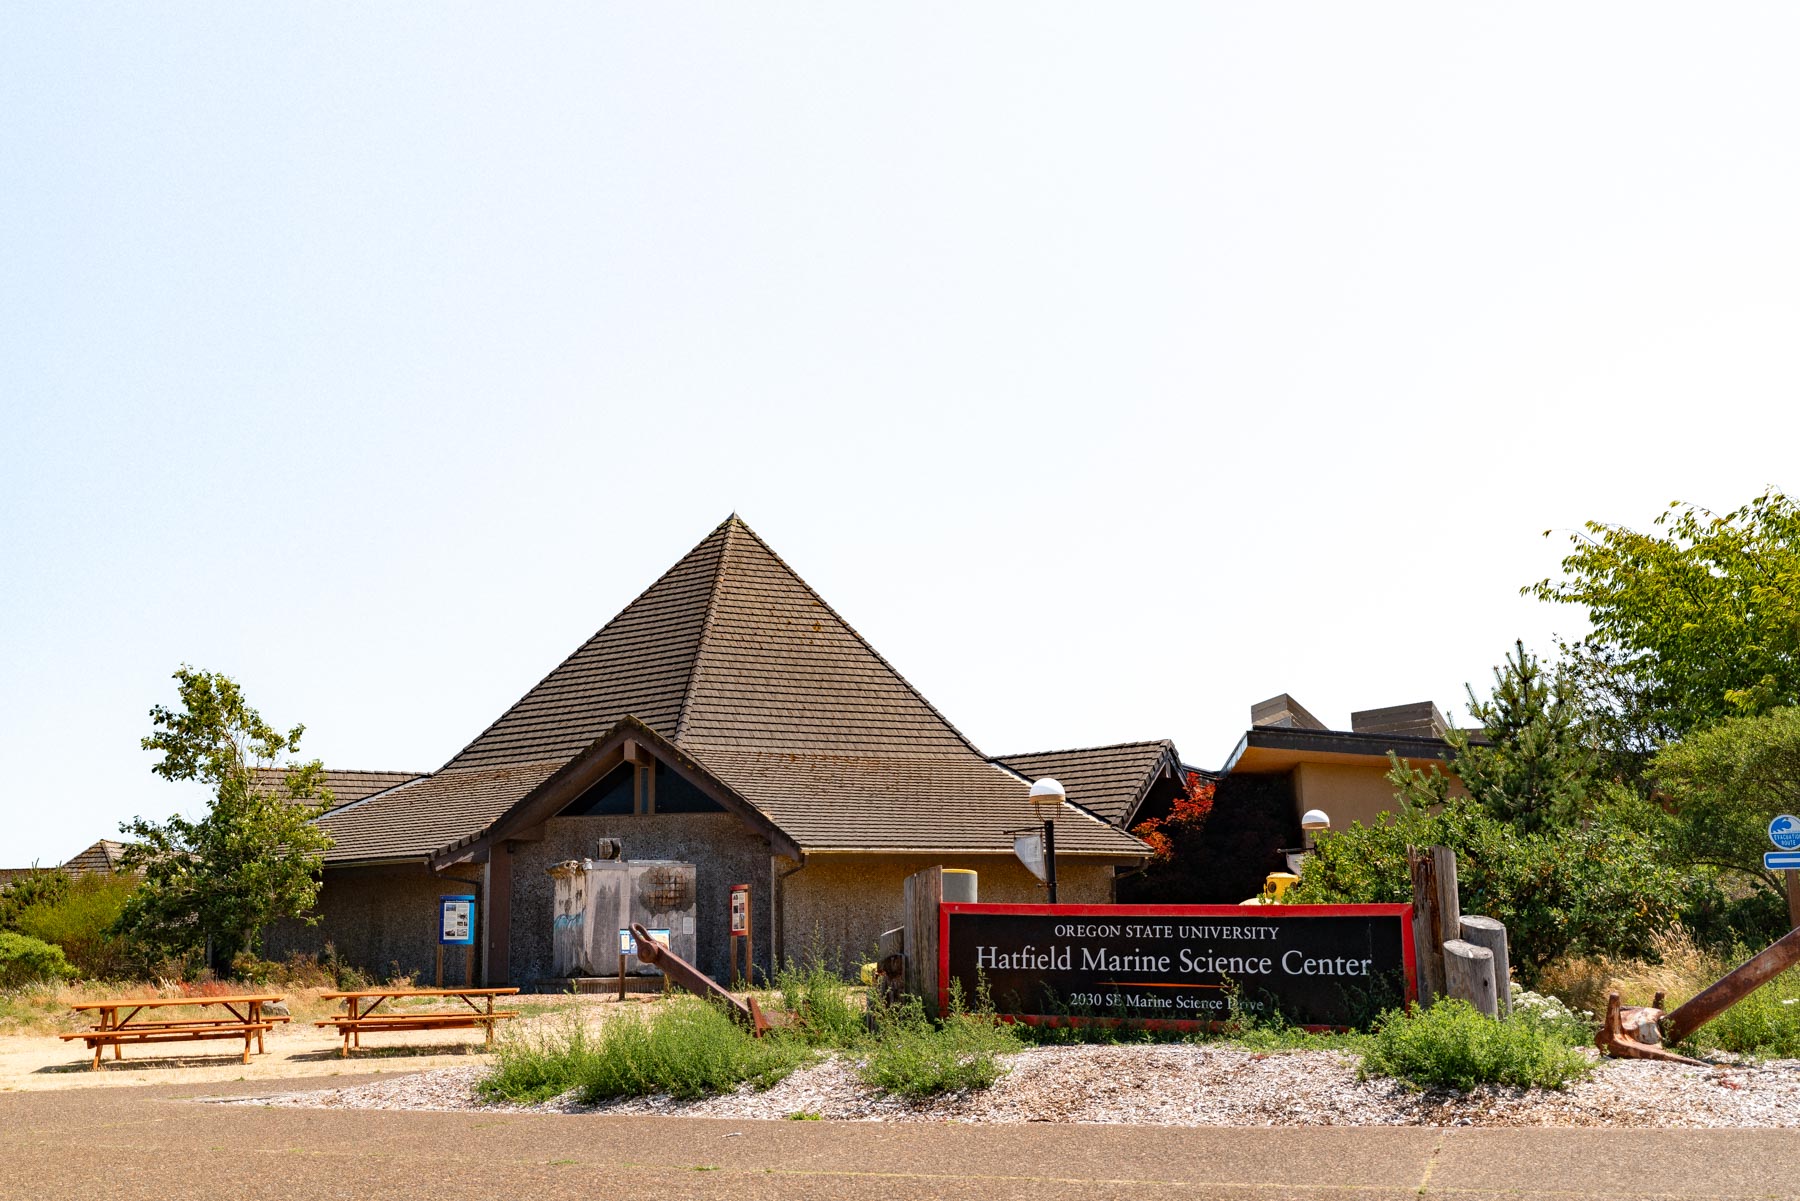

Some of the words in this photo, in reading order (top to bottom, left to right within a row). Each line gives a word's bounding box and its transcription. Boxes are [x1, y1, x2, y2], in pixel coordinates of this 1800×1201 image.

[1054, 925, 1121, 938] OREGON
[1125, 925, 1174, 938] STATE
[1179, 926, 1280, 939] UNIVERSITY
[976, 945, 1072, 970] Hatfield
[1080, 948, 1171, 972] Marine
[1179, 949, 1272, 974] Science
[1282, 950, 1373, 976] Center
[1070, 993, 1101, 1006] 2030
[1106, 994, 1122, 1006] SE
[1126, 995, 1172, 1008] Marine
[1176, 995, 1223, 1009] Science
